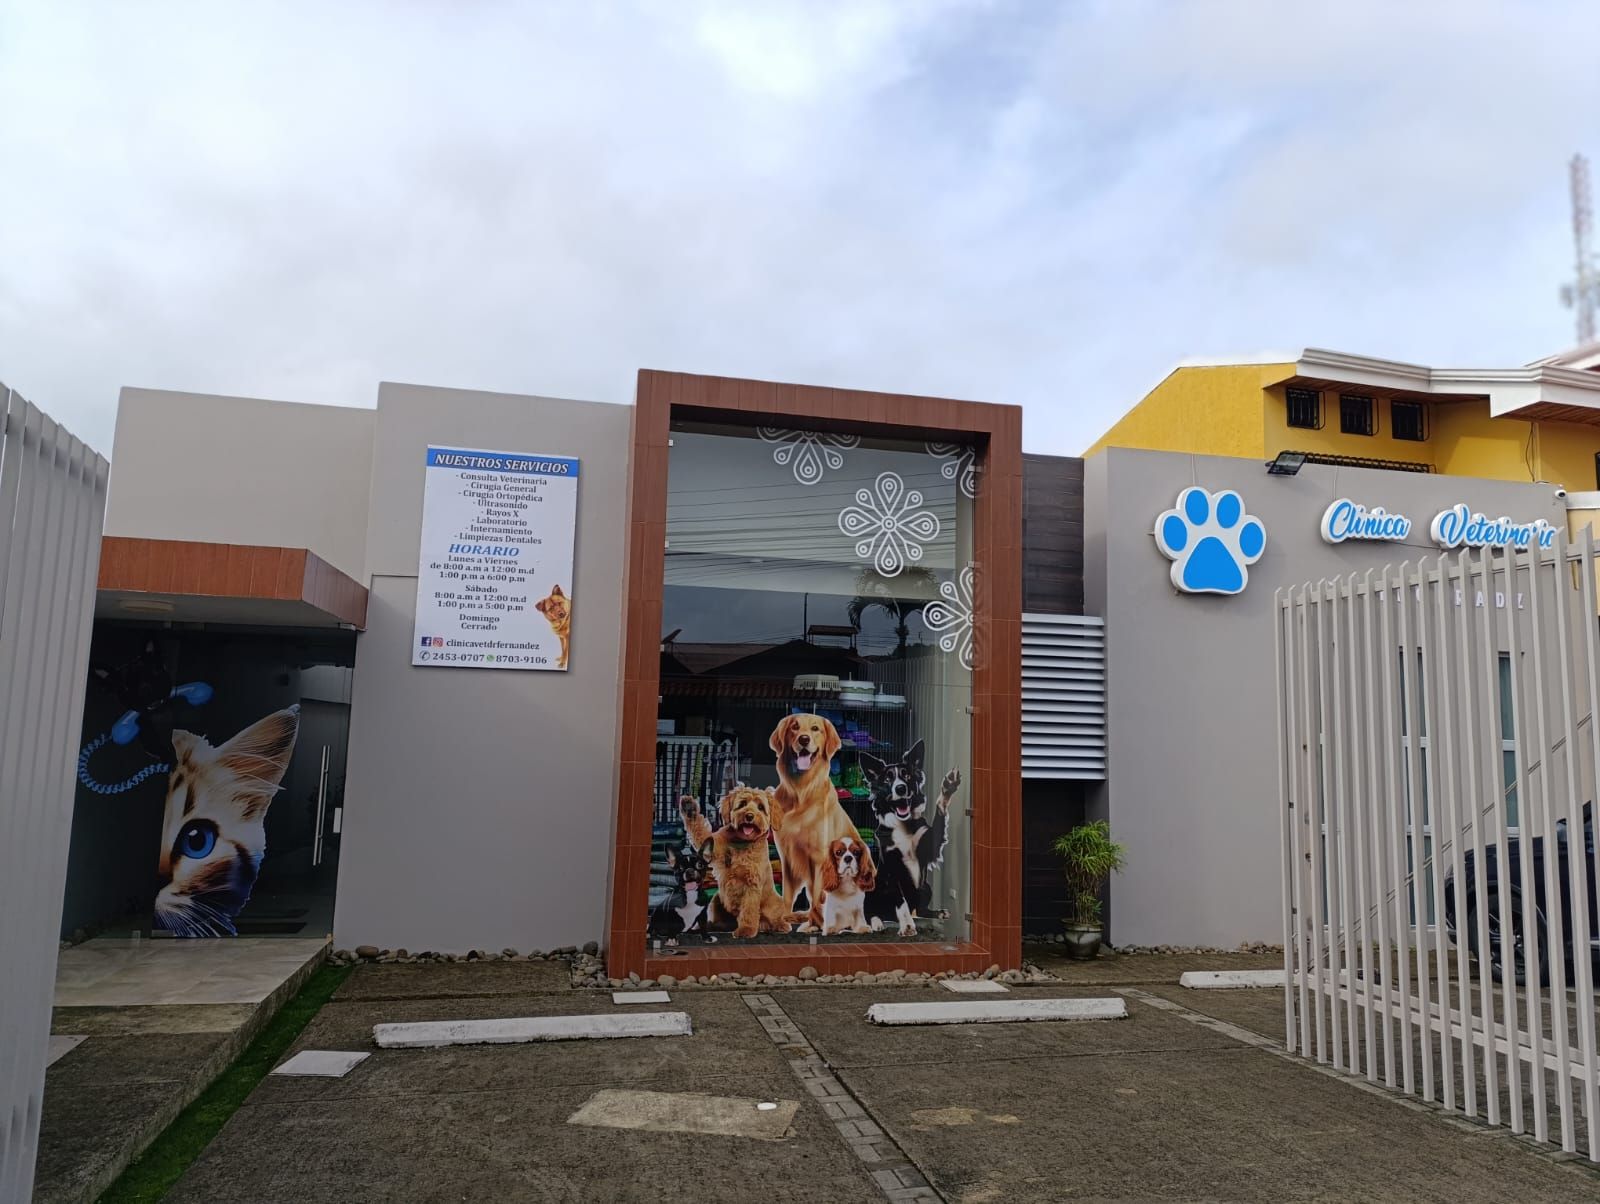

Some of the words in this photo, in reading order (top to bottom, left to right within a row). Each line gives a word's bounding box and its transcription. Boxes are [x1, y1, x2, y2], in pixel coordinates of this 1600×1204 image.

[435, 454, 501, 469] NUESTROS
[504, 459, 569, 474] SERVICIOS
[461, 472, 498, 482] Consulta
[500, 475, 547, 485] Veterinaria
[504, 484, 536, 493] General
[496, 492, 543, 502] Ortopédica
[478, 500, 528, 509] Ultrasonido
[486, 509, 511, 517] Rayos
[476, 517, 527, 526] Laboratorio
[1437, 505, 1557, 546] Veterinaia
[470, 525, 532, 535] Internamiento
[460, 533, 503, 543] Limpiezas
[505, 535, 542, 544] Dentales
[448, 543, 520, 556] HORARIO
[448, 555, 475, 563] Lunes
[484, 557, 518, 565] Viernes
[465, 585, 498, 593] Sábado
[484, 594, 508, 602] 12:00
[460, 614, 500, 623] Domingo
[461, 622, 497, 631] Cerrado
[446, 639, 540, 650] clinicavetdrfernandez
[432, 652, 485, 662] 2453-0707
[496, 655, 547, 664] 8703-9106
